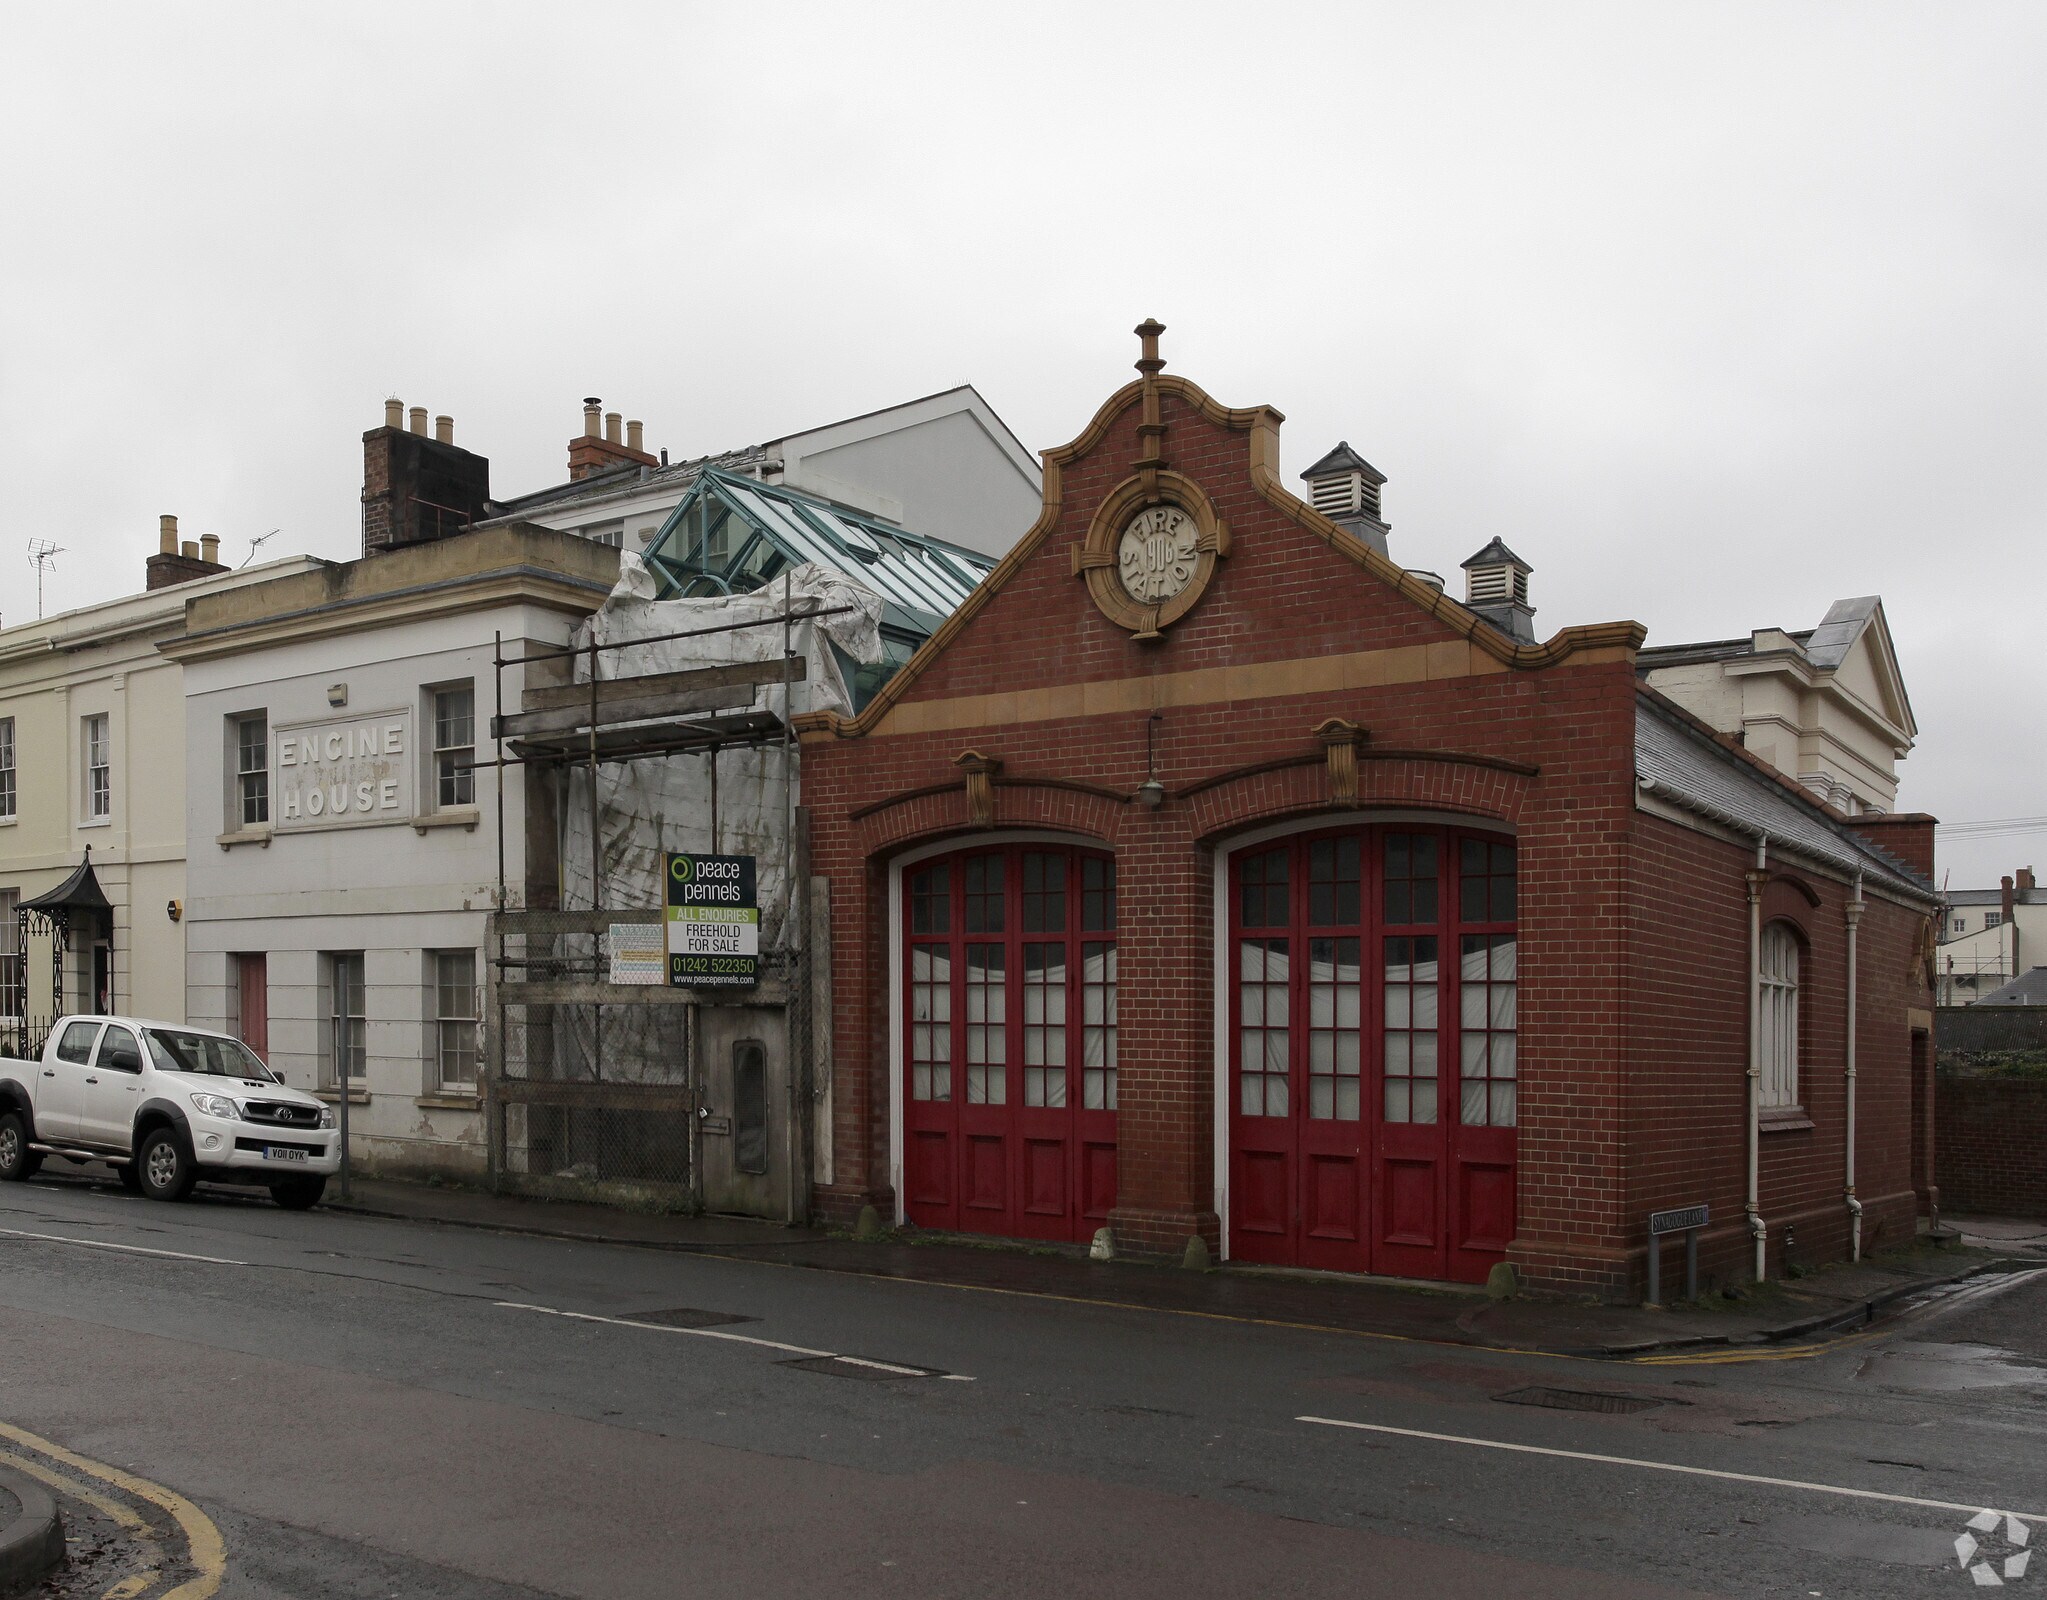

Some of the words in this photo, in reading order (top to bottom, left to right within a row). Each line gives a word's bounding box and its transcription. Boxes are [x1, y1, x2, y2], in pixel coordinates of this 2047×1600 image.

[1133, 510, 1184, 544] FIRE
[1145, 537, 1174, 573] 1906
[1122, 544, 1197, 600] STATION
[284, 779, 399, 819] HOUSE
[696, 861, 740, 881] peace
[684, 881, 741, 903] pennels
[676, 908, 697, 921] ALL
[699, 908, 749, 923] ENQURIES
[686, 924, 741, 938] FREEHOLD
[688, 939, 710, 952] FOR
[712, 939, 740, 953] SALE
[673, 957, 708, 973] 01242
[711, 958, 755, 974] 522350
[673, 974, 755, 986] www.peacepennels.com
[288, 1150, 305, 1161] OYK
[1654, 1211, 1688, 1231] SYNAGOGUE
